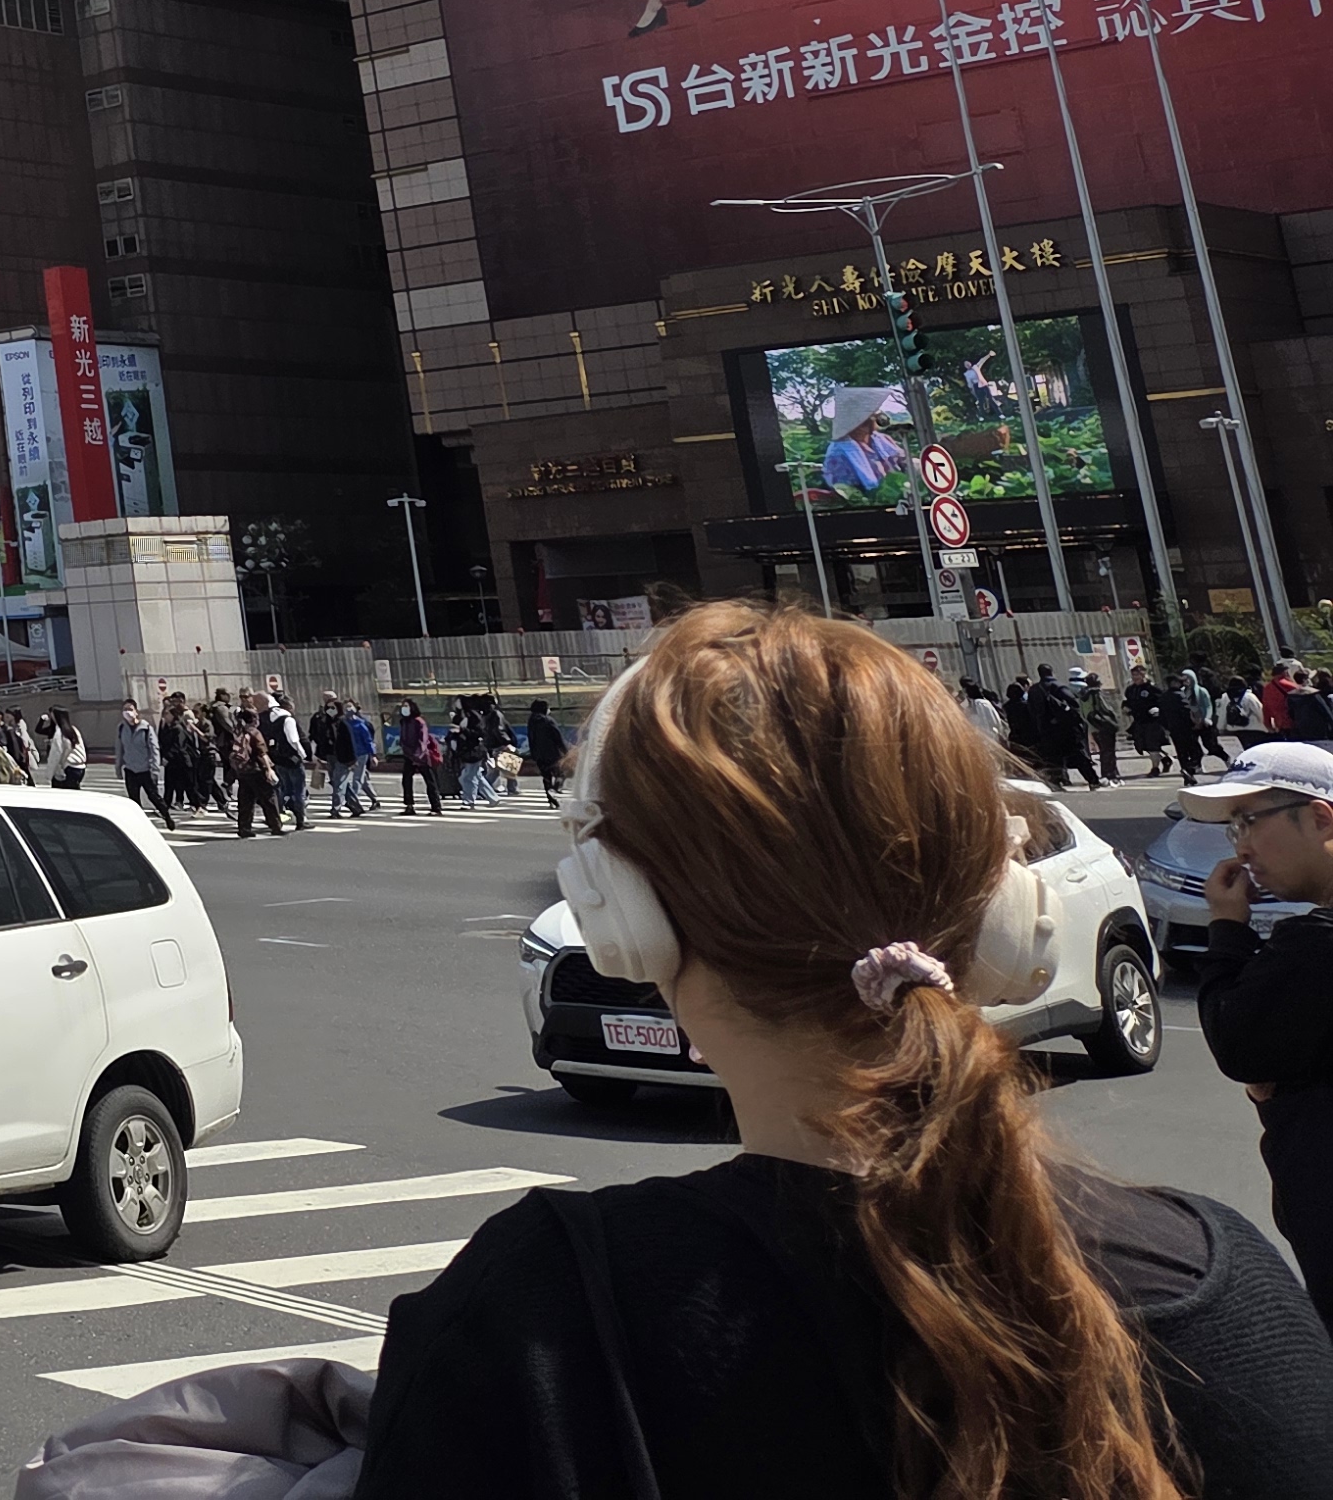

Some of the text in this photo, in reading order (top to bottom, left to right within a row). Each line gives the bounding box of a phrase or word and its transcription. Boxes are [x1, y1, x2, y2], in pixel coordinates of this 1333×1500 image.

[4, 350, 30, 362] EPSON
[69, 314, 104, 445] 新光三越
